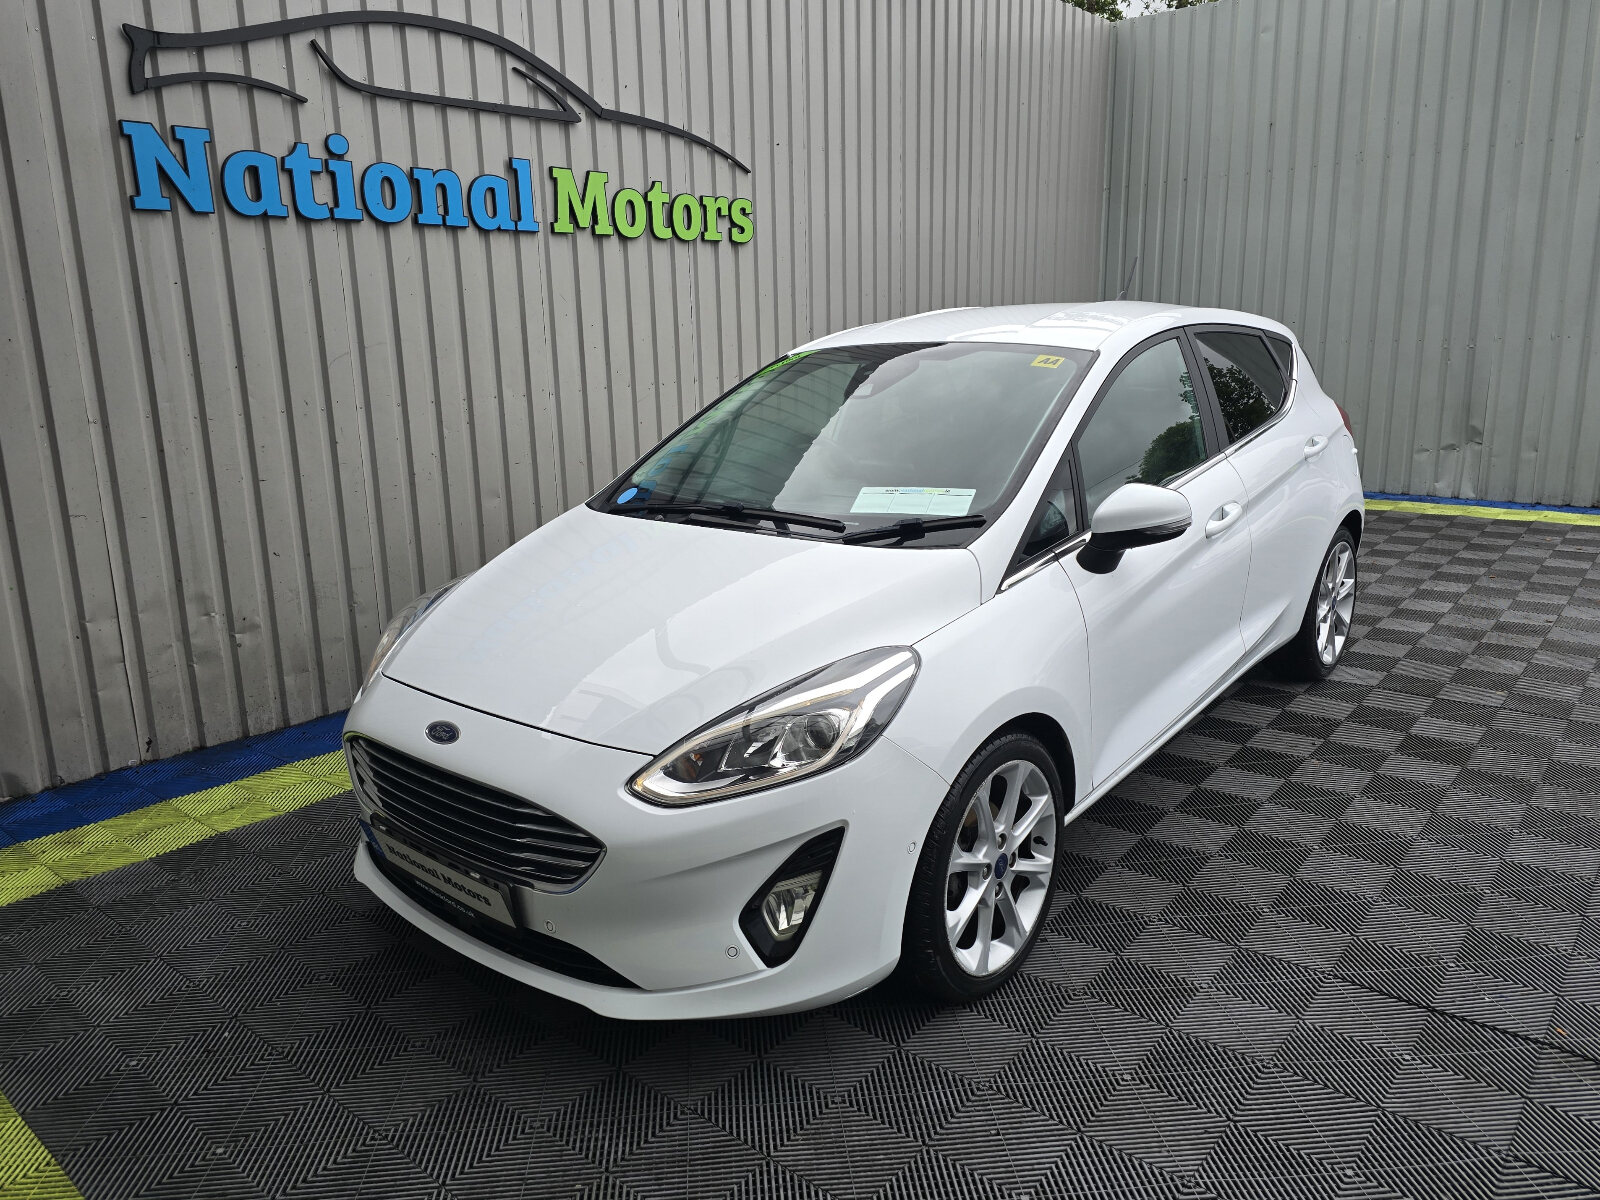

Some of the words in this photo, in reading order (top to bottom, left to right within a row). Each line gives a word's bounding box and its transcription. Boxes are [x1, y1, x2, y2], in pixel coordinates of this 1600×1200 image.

[119, 119, 540, 233] National
[549, 166, 755, 244] Motors
[1037, 357, 1061, 366] AA
[386, 843, 442, 881] National
[440, 872, 492, 907] Motors
